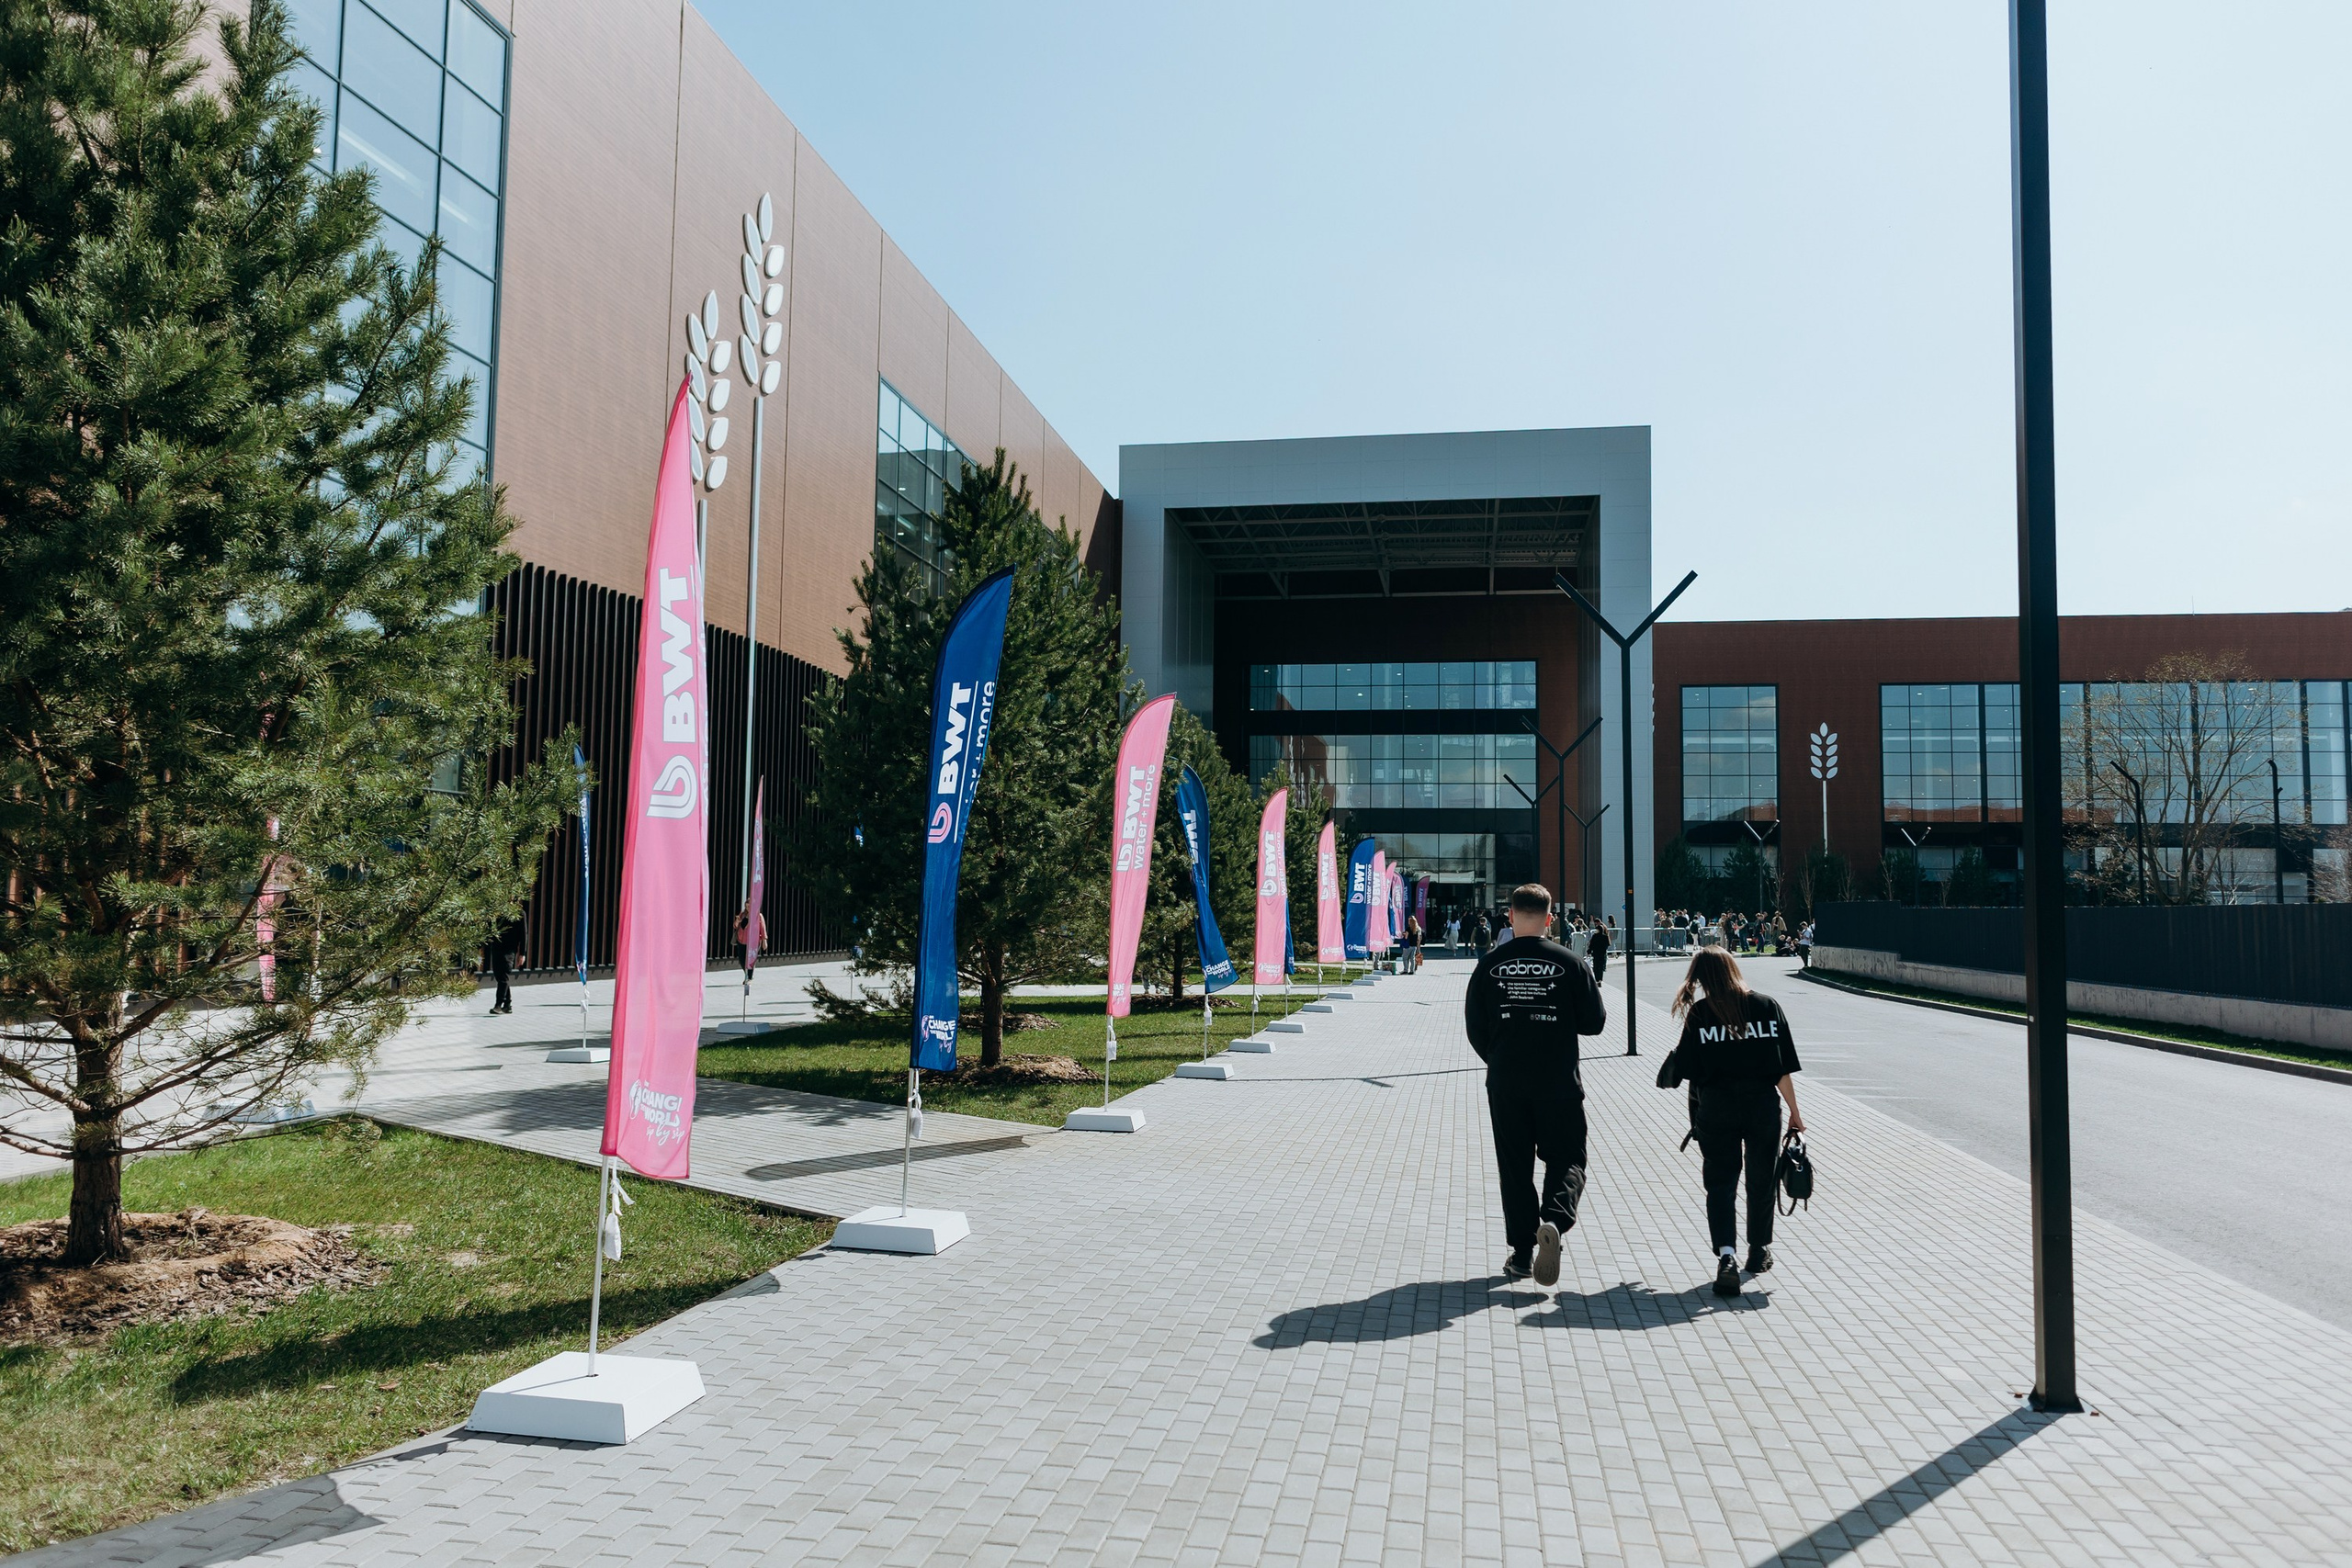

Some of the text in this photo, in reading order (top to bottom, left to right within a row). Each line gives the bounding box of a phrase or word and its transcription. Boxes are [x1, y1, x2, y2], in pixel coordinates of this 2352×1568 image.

[659, 567, 696, 743] BWT
[937, 682, 971, 795] BWT
[1121, 766, 1145, 839] BWT
[1134, 764, 1156, 870] water + more
[1264, 831, 1276, 877] BWT
[1354, 862, 1365, 891] BWT
[1498, 959, 1556, 976] nobrow
[928, 1019, 956, 1031] CHGE
[656, 1122, 670, 1146] by
